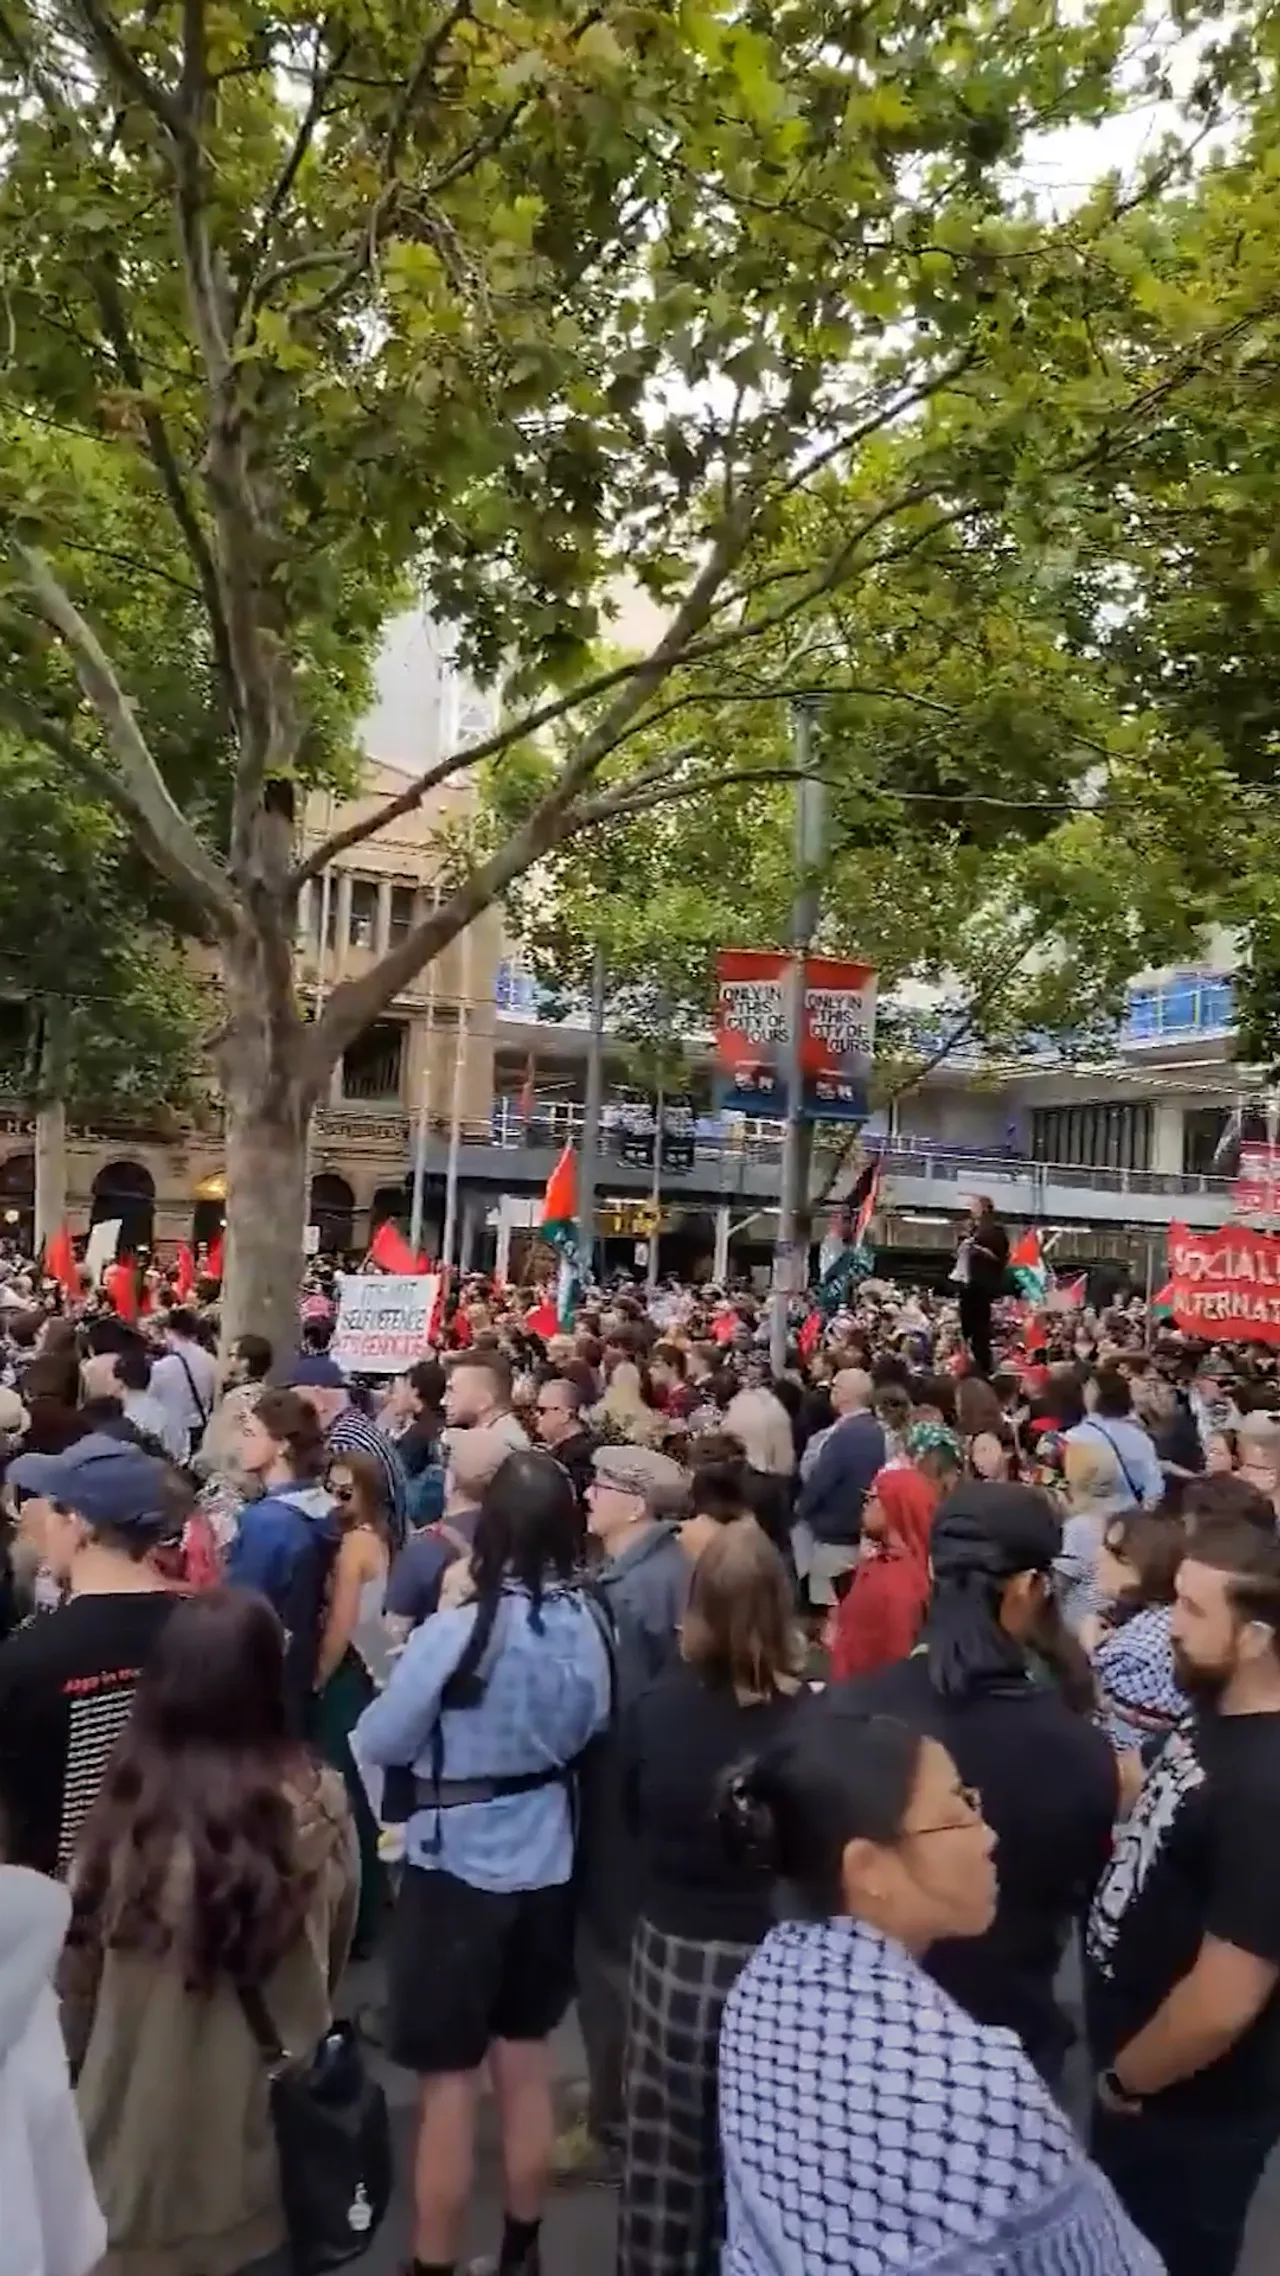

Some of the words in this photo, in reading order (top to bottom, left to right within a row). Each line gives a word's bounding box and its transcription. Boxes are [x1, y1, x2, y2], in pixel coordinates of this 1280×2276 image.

[724, 984, 759, 1001] ONLY
[764, 986, 783, 1000] IN
[737, 1001, 772, 1014] THIS
[808, 993, 844, 1010] ONLY
[847, 994, 863, 1009] IN
[727, 1014, 764, 1031] CITY
[768, 1015, 786, 1028] OF
[821, 1009, 852, 1023] THIS
[750, 1029, 789, 1043] OURS
[812, 1024, 843, 1040] CITY
[847, 1024, 868, 1037] OF
[830, 1038, 871, 1053] OURS
[7, 1120, 99, 1139] HOEL
